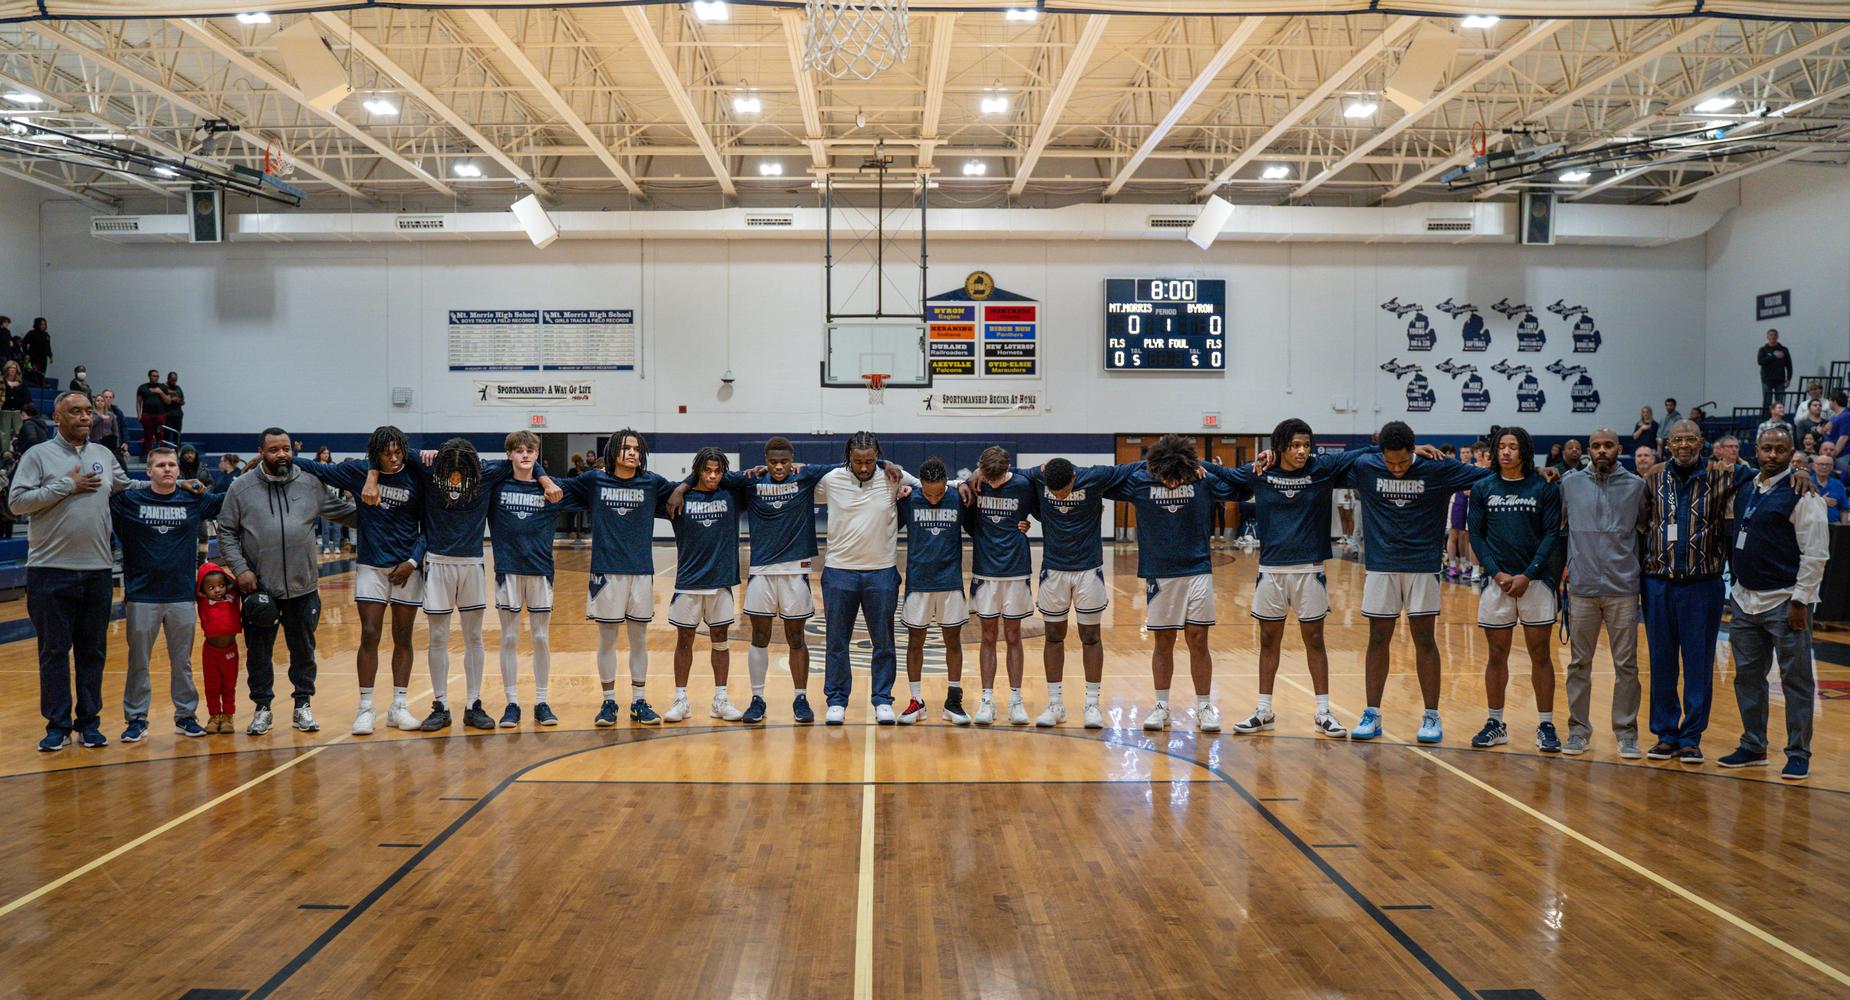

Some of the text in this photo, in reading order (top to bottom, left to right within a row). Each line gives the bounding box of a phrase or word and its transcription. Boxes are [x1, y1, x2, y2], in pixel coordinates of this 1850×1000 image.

[1151, 281, 1194, 300] 8:00
[1187, 304, 1213, 313] BYRON
[495, 312, 513, 320] High
[589, 312, 607, 320] High
[1128, 315, 1140, 334] 0
[1166, 318, 1171, 332] 1
[1209, 316, 1222, 335] 0
[1109, 338, 1126, 348] FLS
[1143, 338, 1189, 349] PLYR FOUL
[1206, 339, 1222, 349] FLS
[1114, 351, 1125, 367] 0
[1211, 351, 1221, 367] 0
[497, 385, 591, 394] SPORTSMANSHIP: A WAY OF LIFE
[942, 394, 1036, 404] SPORTSMANSHIP BEGINS AT HOME
[756, 482, 799, 496] PANTHERS
[1150, 485, 1194, 500] PANTHERS
[1376, 478, 1425, 493] PANTHERS
[378, 484, 410, 502] NTHERS
[501, 491, 545, 507] PANTHERS
[601, 487, 644, 502] PANTHERS
[686, 500, 728, 514] PANTHERS
[977, 495, 1019, 511] PANTHERS
[139, 505, 187, 520] PANTHERS
[913, 508, 958, 522] PANTHERS
